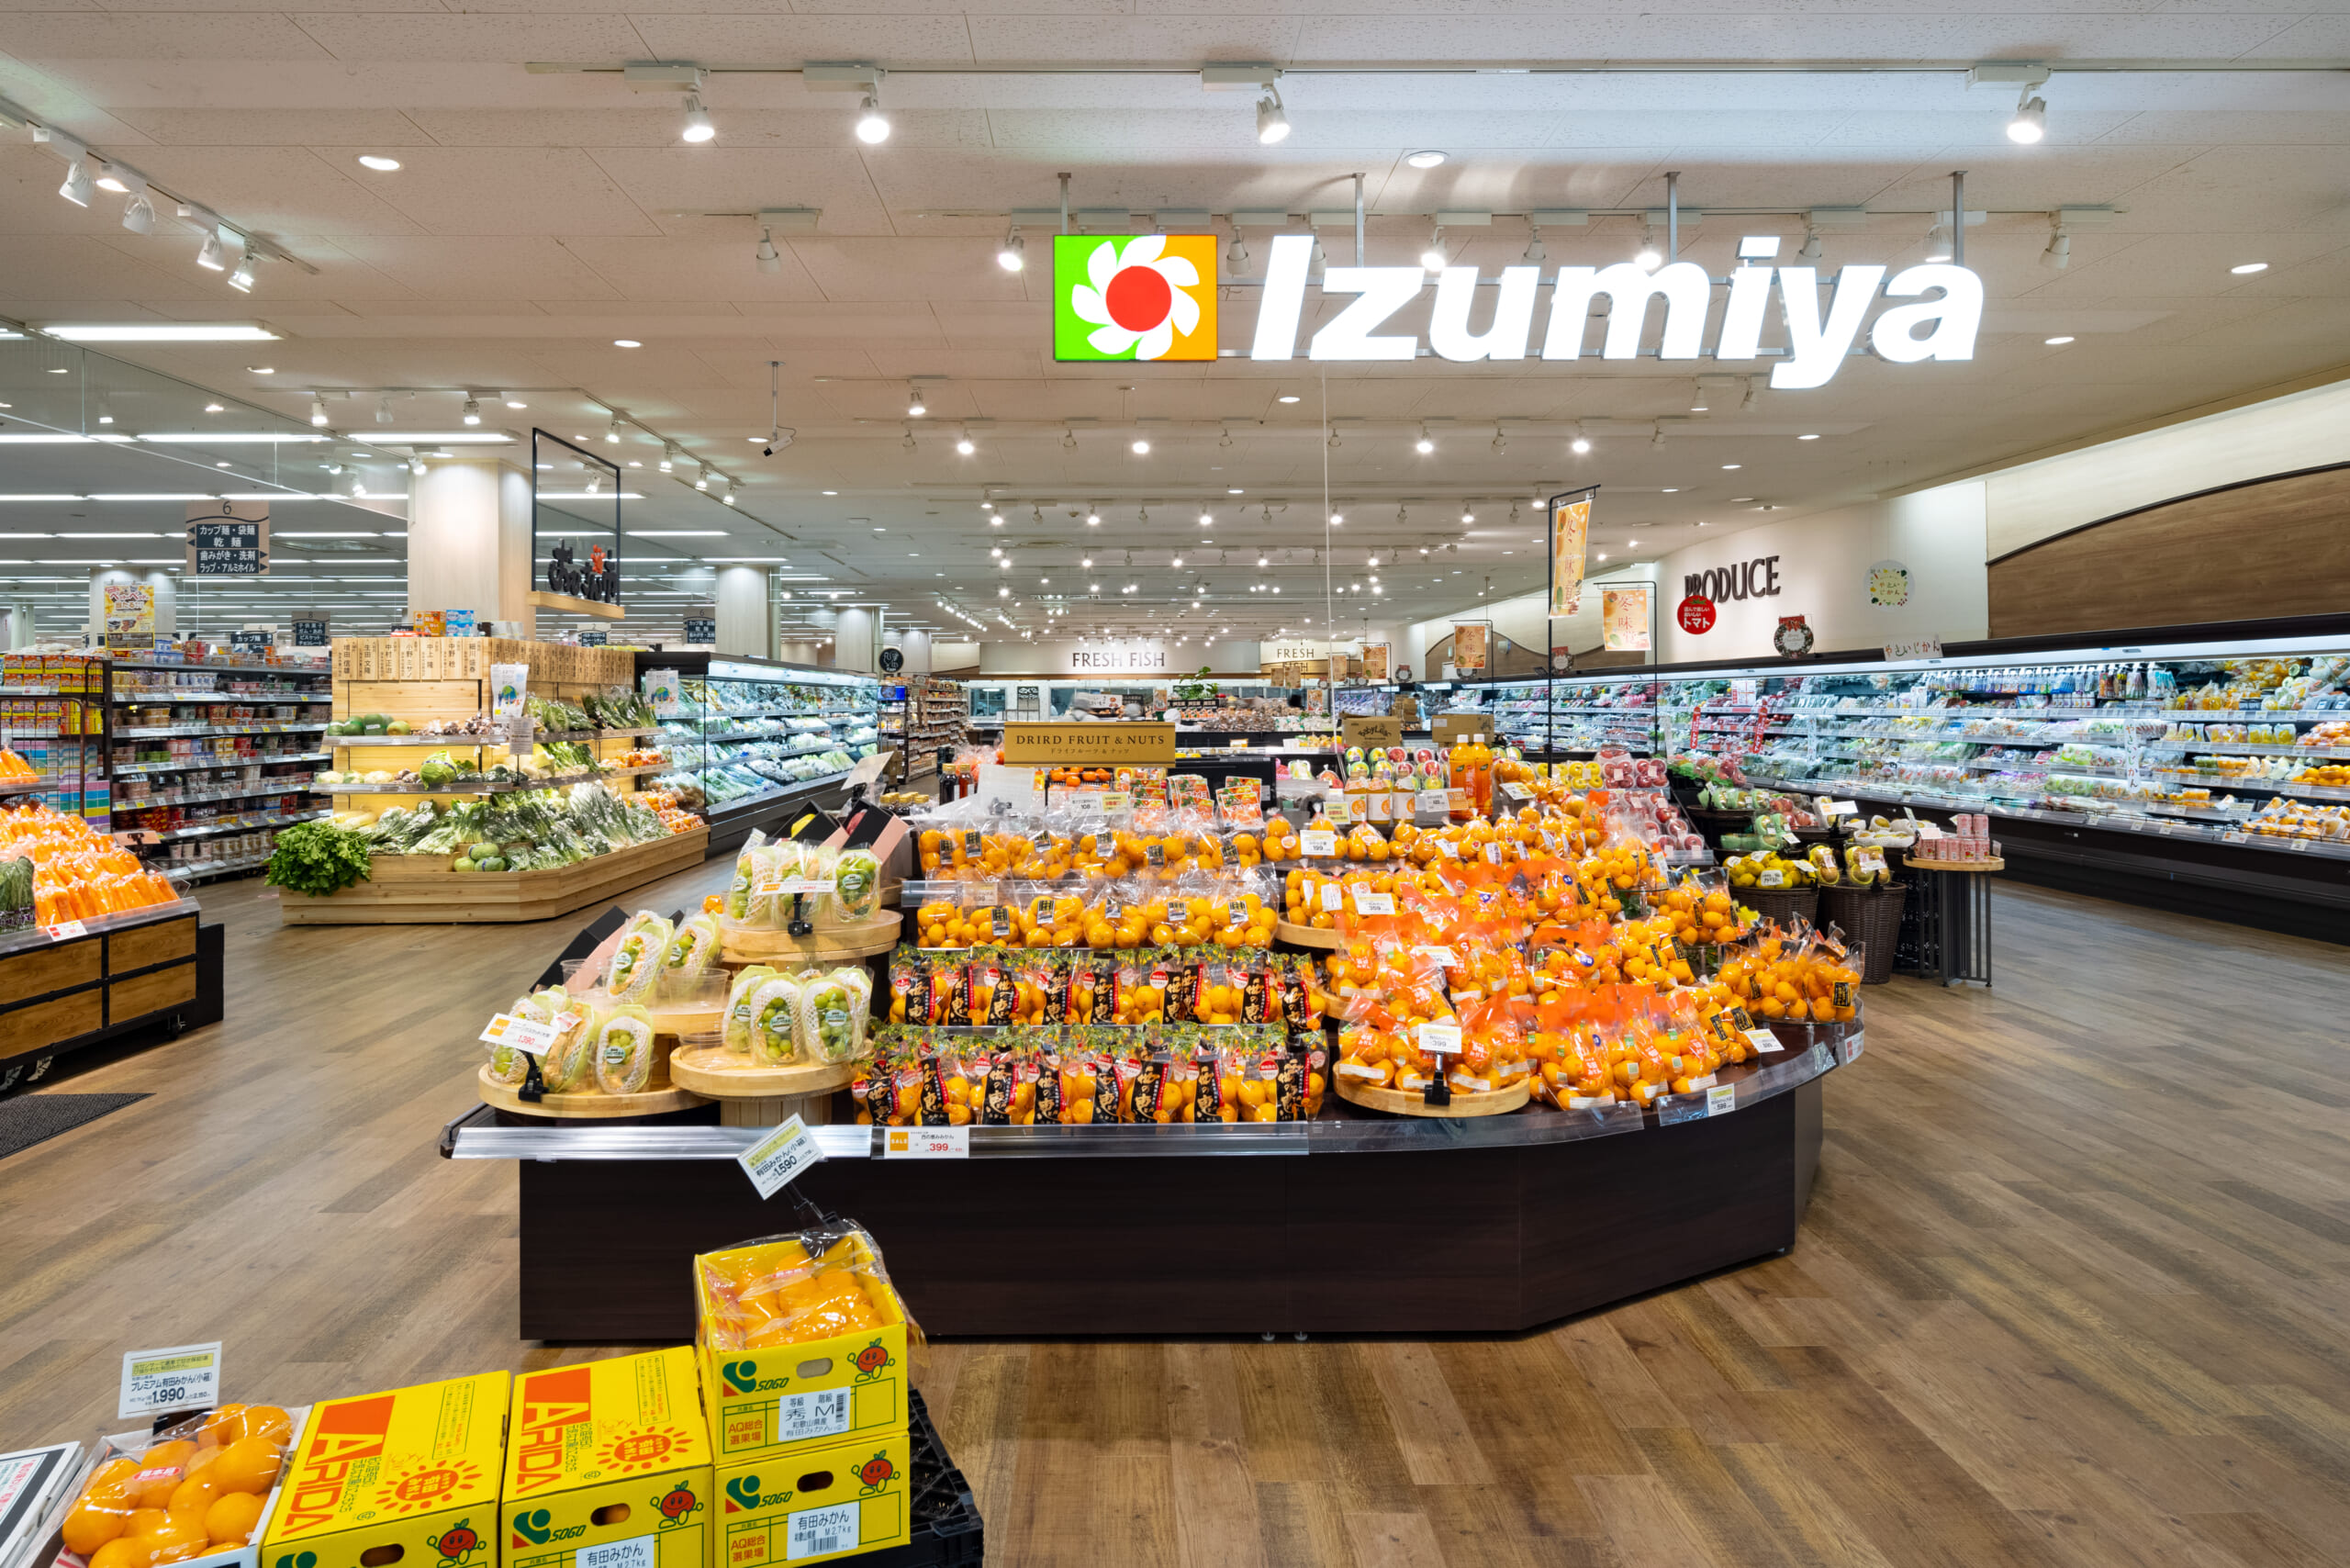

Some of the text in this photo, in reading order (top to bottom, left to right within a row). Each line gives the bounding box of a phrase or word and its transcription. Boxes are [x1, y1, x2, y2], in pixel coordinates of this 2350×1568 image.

[1250, 234, 1985, 389] Izumiya
[222, 500, 232, 515] 6
[199, 524, 256, 535] カップ麺・袋麺
[199, 550, 256, 561] 歯みがき・洗剤
[199, 562, 256, 573] ラップ・アルミホイル
[1684, 555, 1781, 604] PRODUCE
[1684, 617, 1710, 628] トマト
[1072, 653, 1165, 666] FRESH FISH
[1277, 648, 1315, 658] FRESH
[1016, 735, 1165, 745] DRIRD FRUIT & NUTS
[929, 1142, 949, 1152] 399
[755, 1378, 789, 1392] SOGO
[789, 1396, 804, 1407] 等級
[785, 1404, 834, 1422] 秀 M
[728, 1419, 763, 1434] AQ総合
[792, 1417, 827, 1428] 和歌山県産
[730, 1431, 761, 1446] 選果場
[786, 1426, 832, 1438] 有田みかん
[516, 1402, 589, 1495] ARIDA
[280, 1433, 385, 1537] ARIDA
[759, 1491, 793, 1507] SOGO
[798, 1509, 850, 1531] 有田みかん
[549, 1525, 587, 1542] SOGO
[731, 1535, 766, 1551] AQ総合
[588, 1543, 643, 1566] 有田みかん
[733, 1547, 765, 1562] 選果場
